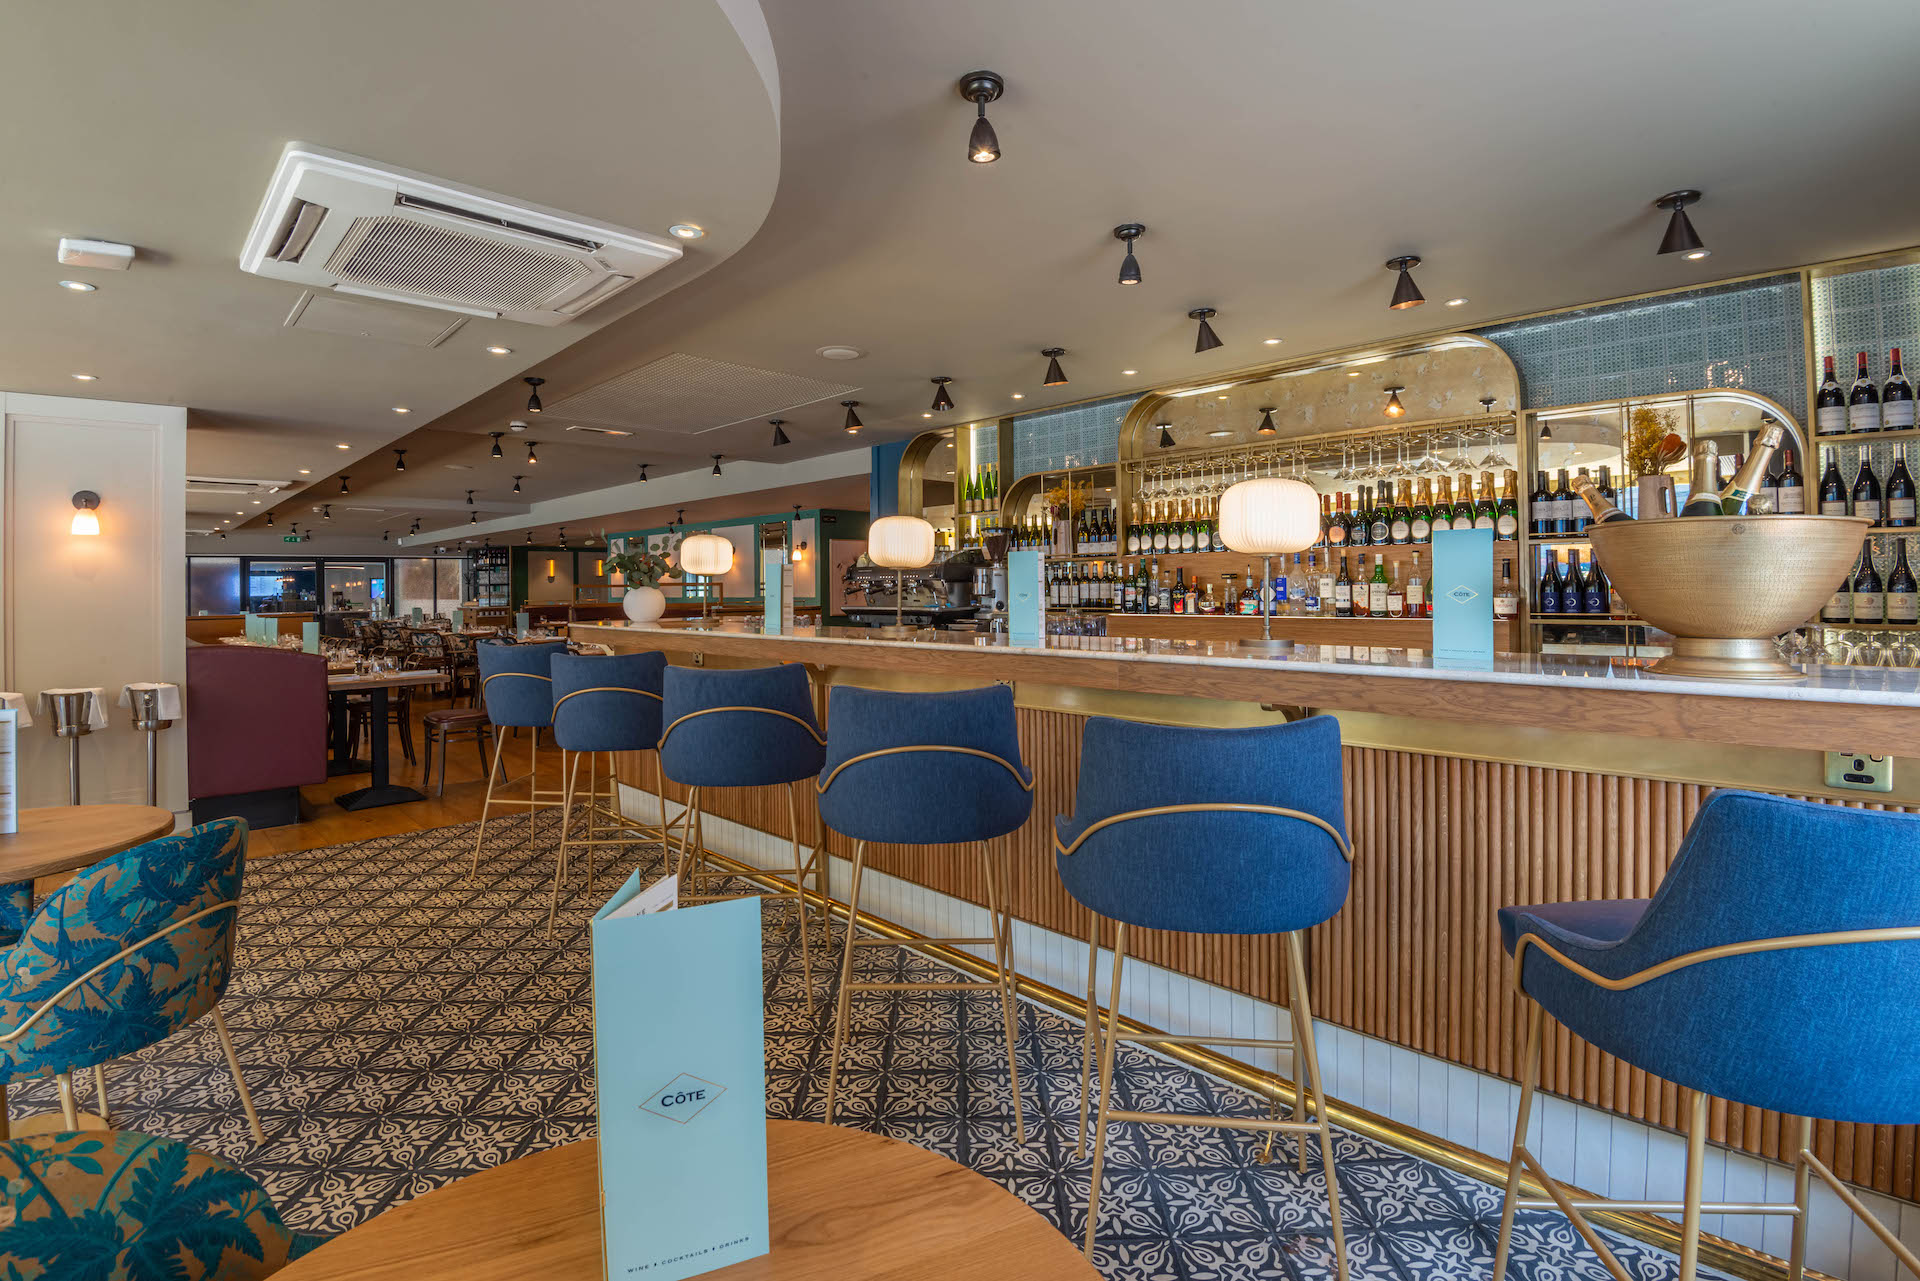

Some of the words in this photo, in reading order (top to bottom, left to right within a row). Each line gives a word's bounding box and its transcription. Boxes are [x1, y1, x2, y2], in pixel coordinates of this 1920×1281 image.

[661, 1089, 706, 1107] CÔTE
[627, 1264, 649, 1273] WINE
[661, 1248, 709, 1265] COCKTAILS
[719, 1236, 750, 1249] DRINKS
